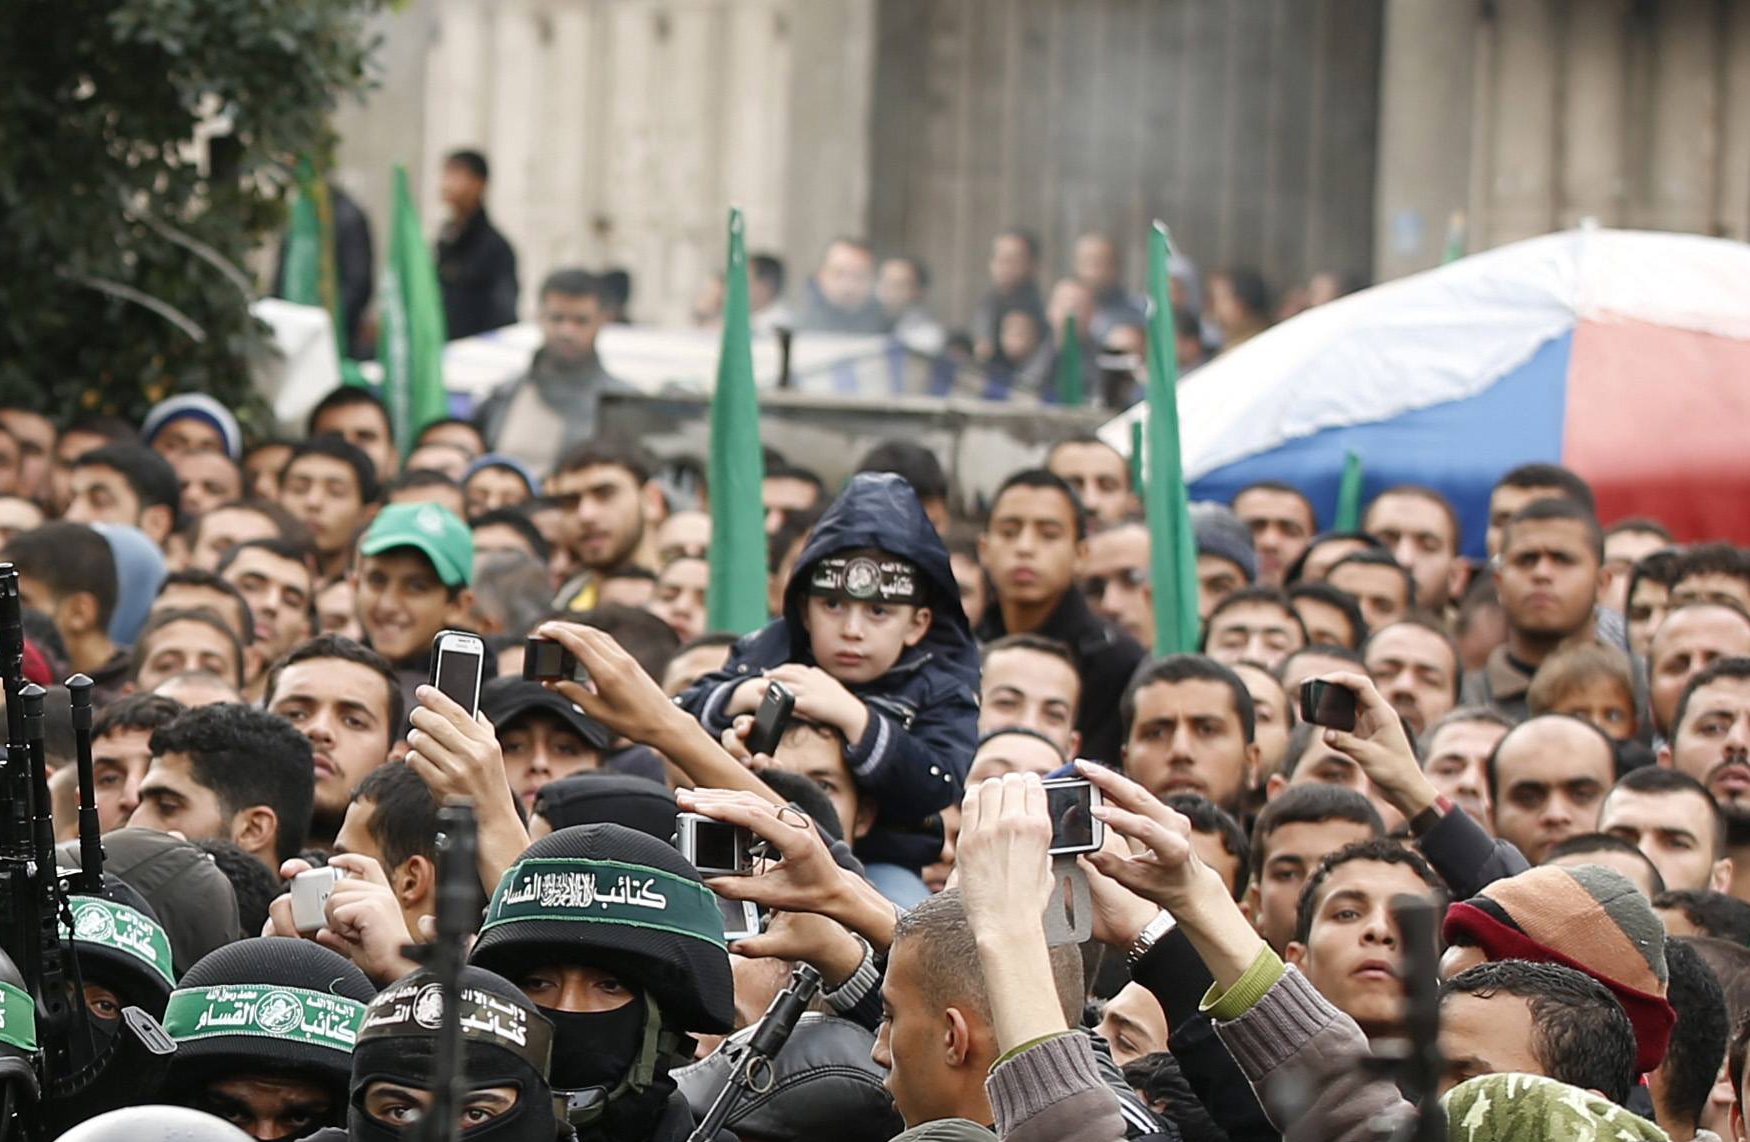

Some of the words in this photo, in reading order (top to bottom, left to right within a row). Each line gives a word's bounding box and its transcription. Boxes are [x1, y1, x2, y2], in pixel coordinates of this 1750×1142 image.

[497, 872, 542, 917] القسام
[594, 874, 666, 909] كتائب
[113, 925, 156, 961] كتائب
[194, 1001, 256, 1030] القسام
[300, 1012, 357, 1045] كتائب
[459, 1011, 527, 1047] كتائب
